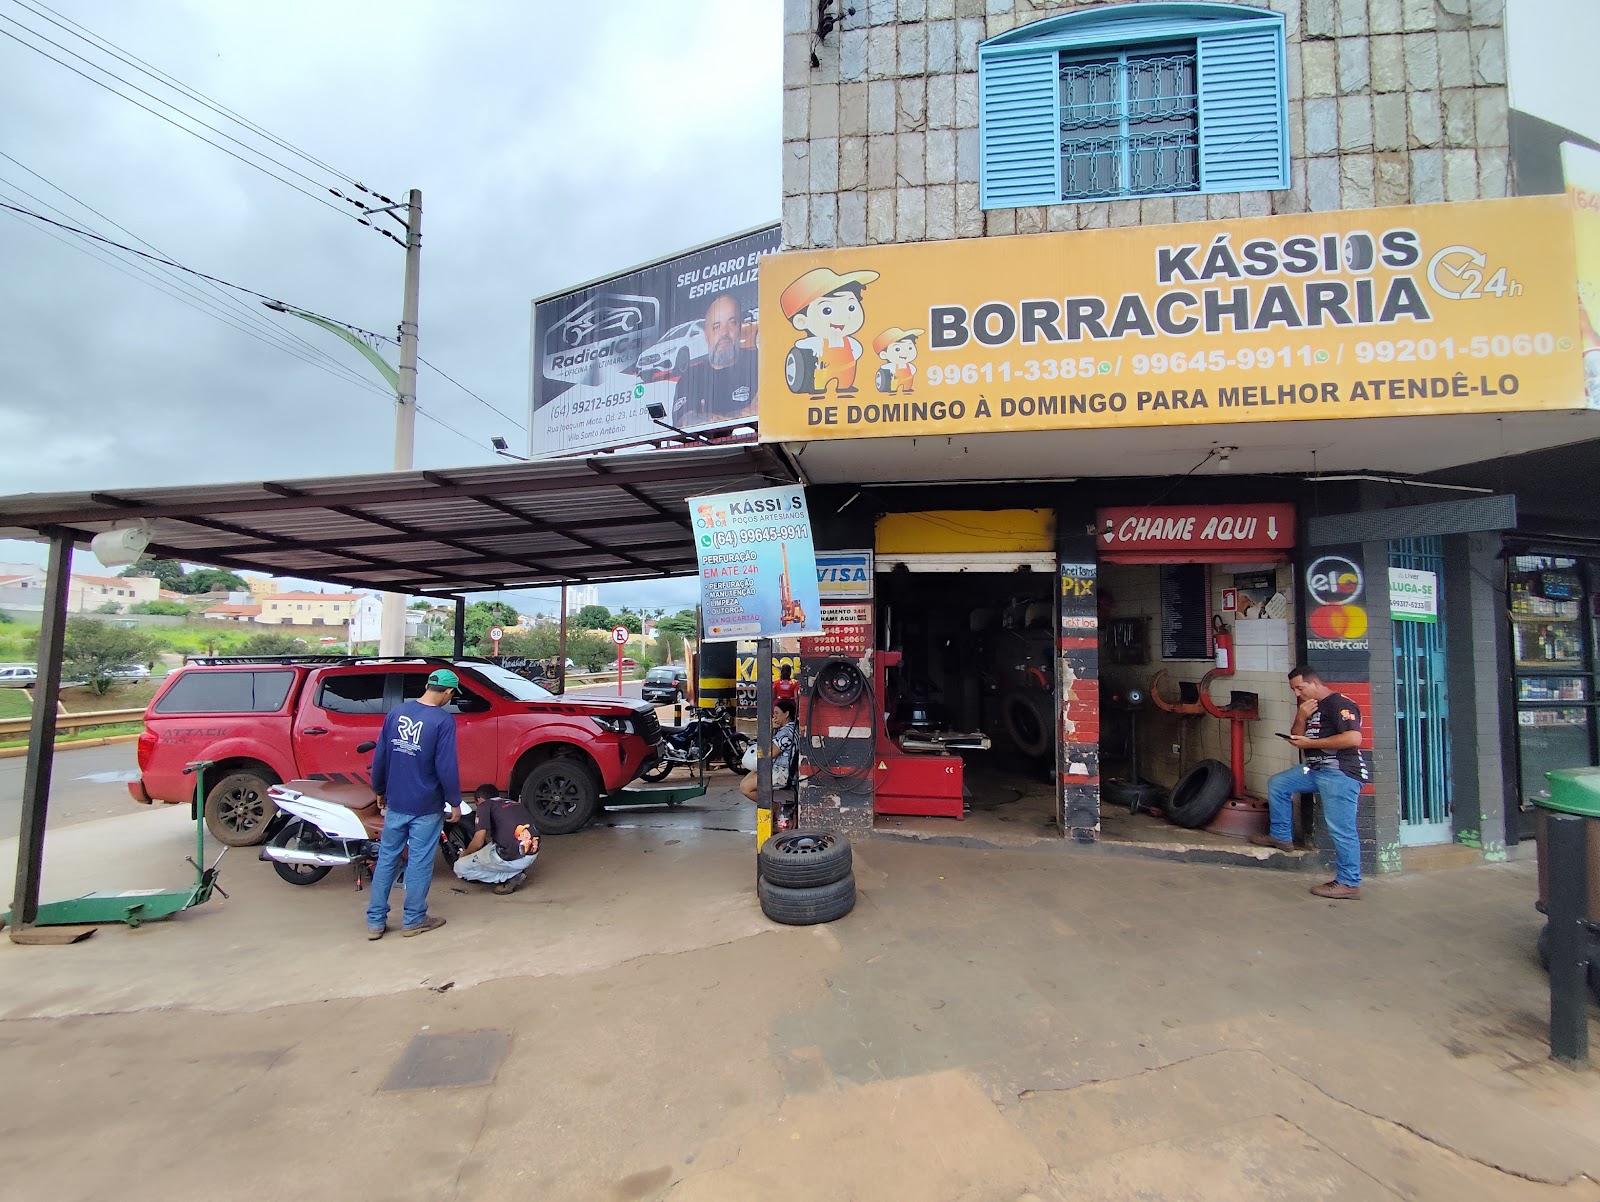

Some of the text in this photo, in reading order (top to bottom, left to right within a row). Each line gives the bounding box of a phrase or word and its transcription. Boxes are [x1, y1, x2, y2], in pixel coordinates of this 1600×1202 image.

[677, 269, 700, 288] SEU
[702, 256, 745, 280] CARRO
[689, 268, 759, 299] ESPECIALIZ
[1460, 267, 1525, 300] 24h
[930, 275, 1433, 350] BORRACHARIA
[927, 357, 1095, 386] 99611-3385
[1132, 344, 1314, 375] 99645-9911
[1355, 332, 1554, 364] 99201-5060
[565, 364, 588, 377] OFICINA
[551, 391, 632, 420] (64) 99212-6953
[808, 371, 1520, 426] DE DOMINGO À DOMINGO PARA MELHOR ATENDÊ-LO
[547, 425, 559, 434] Rua
[732, 511, 805, 526] POÇOS ARTESIANOS
[713, 523, 809, 549] (64) 99645-9911
[1118, 516, 1258, 542] CHAME AQUI
[702, 550, 758, 566] PERFURAÇÃO
[703, 564, 759, 579] EM ATÉ 24h
[816, 568, 867, 582] VISA
[709, 578, 755, 590] PERFURAÇÃO
[1311, 571, 1357, 594] elo
[709, 587, 757, 599] MANUTENÇÃO
[710, 597, 740, 607] LIMPEZA
[720, 616, 731, 624] NO
[616, 629, 624, 641] E
[814, 635, 866, 643] 99201-5060
[1307, 639, 1369, 650] mastercard
[162, 728, 228, 737] ATTACK
[398, 715, 423, 744] RM
